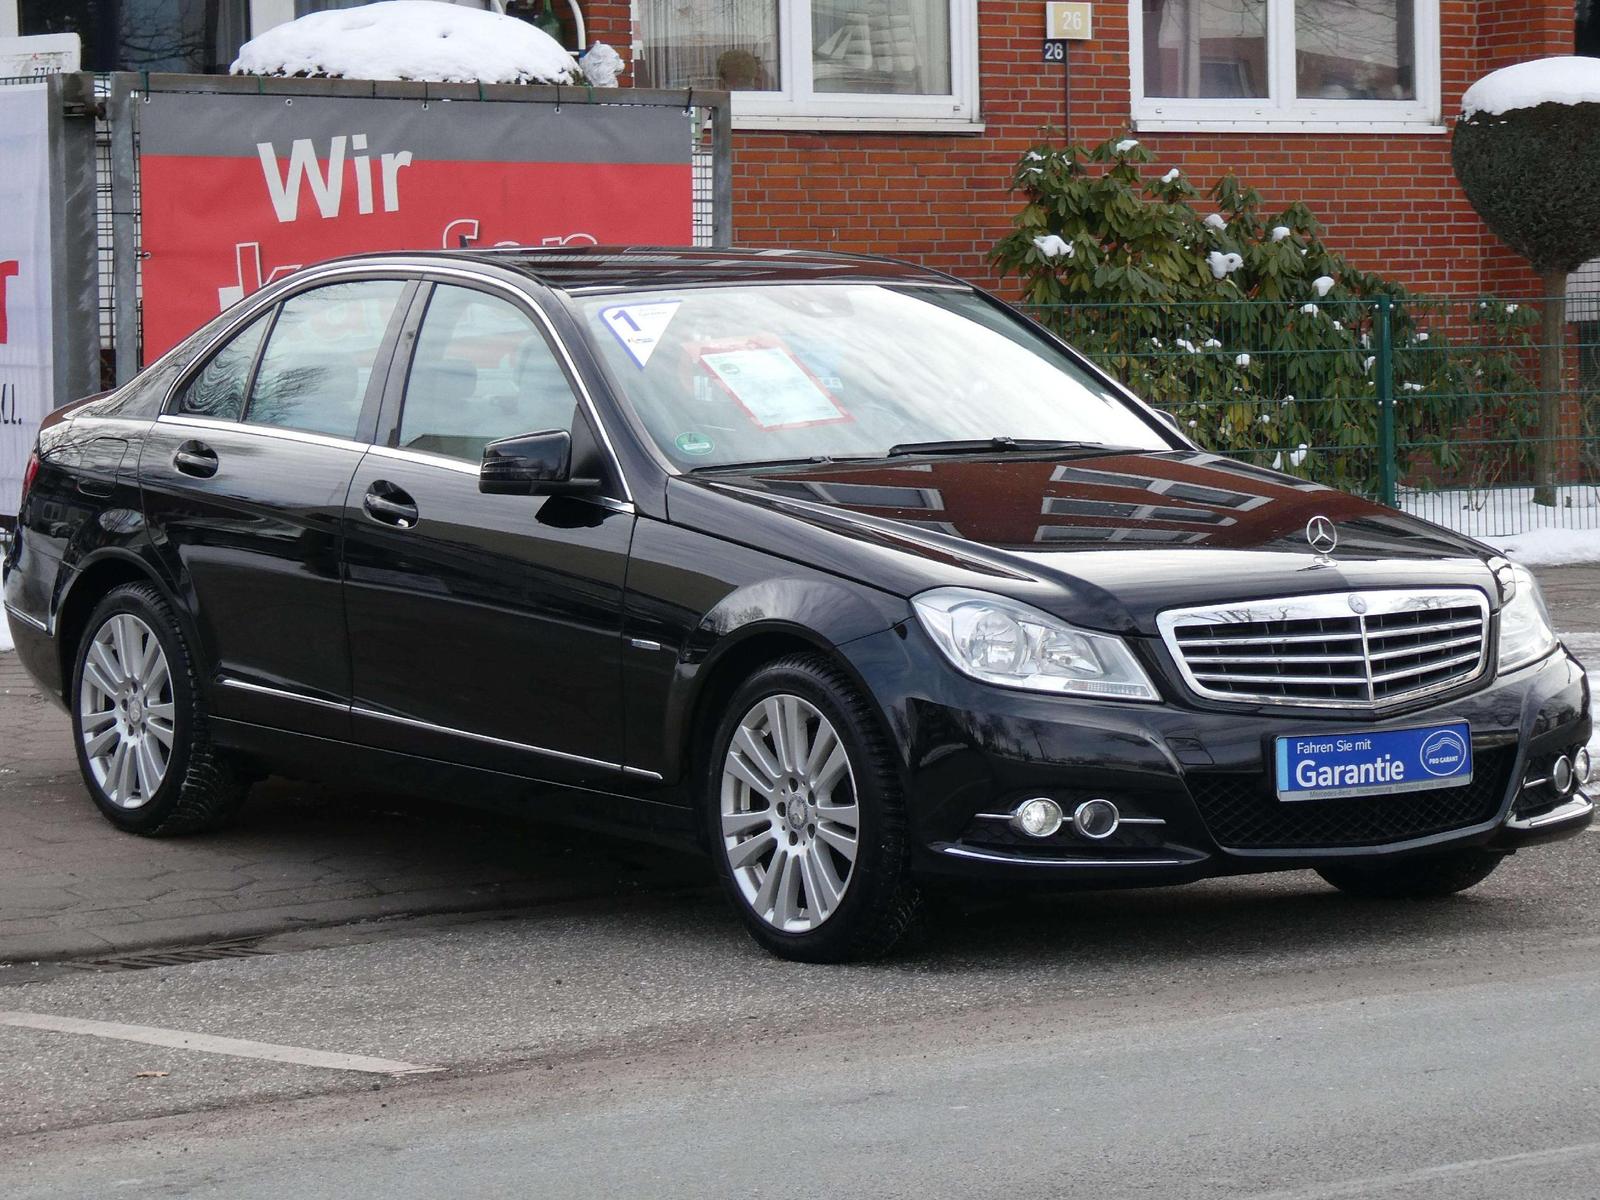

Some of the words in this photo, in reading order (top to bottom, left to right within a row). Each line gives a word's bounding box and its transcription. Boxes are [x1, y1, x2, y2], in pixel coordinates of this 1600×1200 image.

[1062, 11, 1082, 30] 26
[1044, 42, 1064, 60] 26
[256, 134, 413, 222] Wir
[612, 310, 641, 332] 1
[1296, 740, 1334, 754] Fahren
[1336, 739, 1353, 753] Sie
[1355, 738, 1372, 751] mit
[1440, 755, 1459, 763] GARANT
[1295, 753, 1405, 788] Garantie
